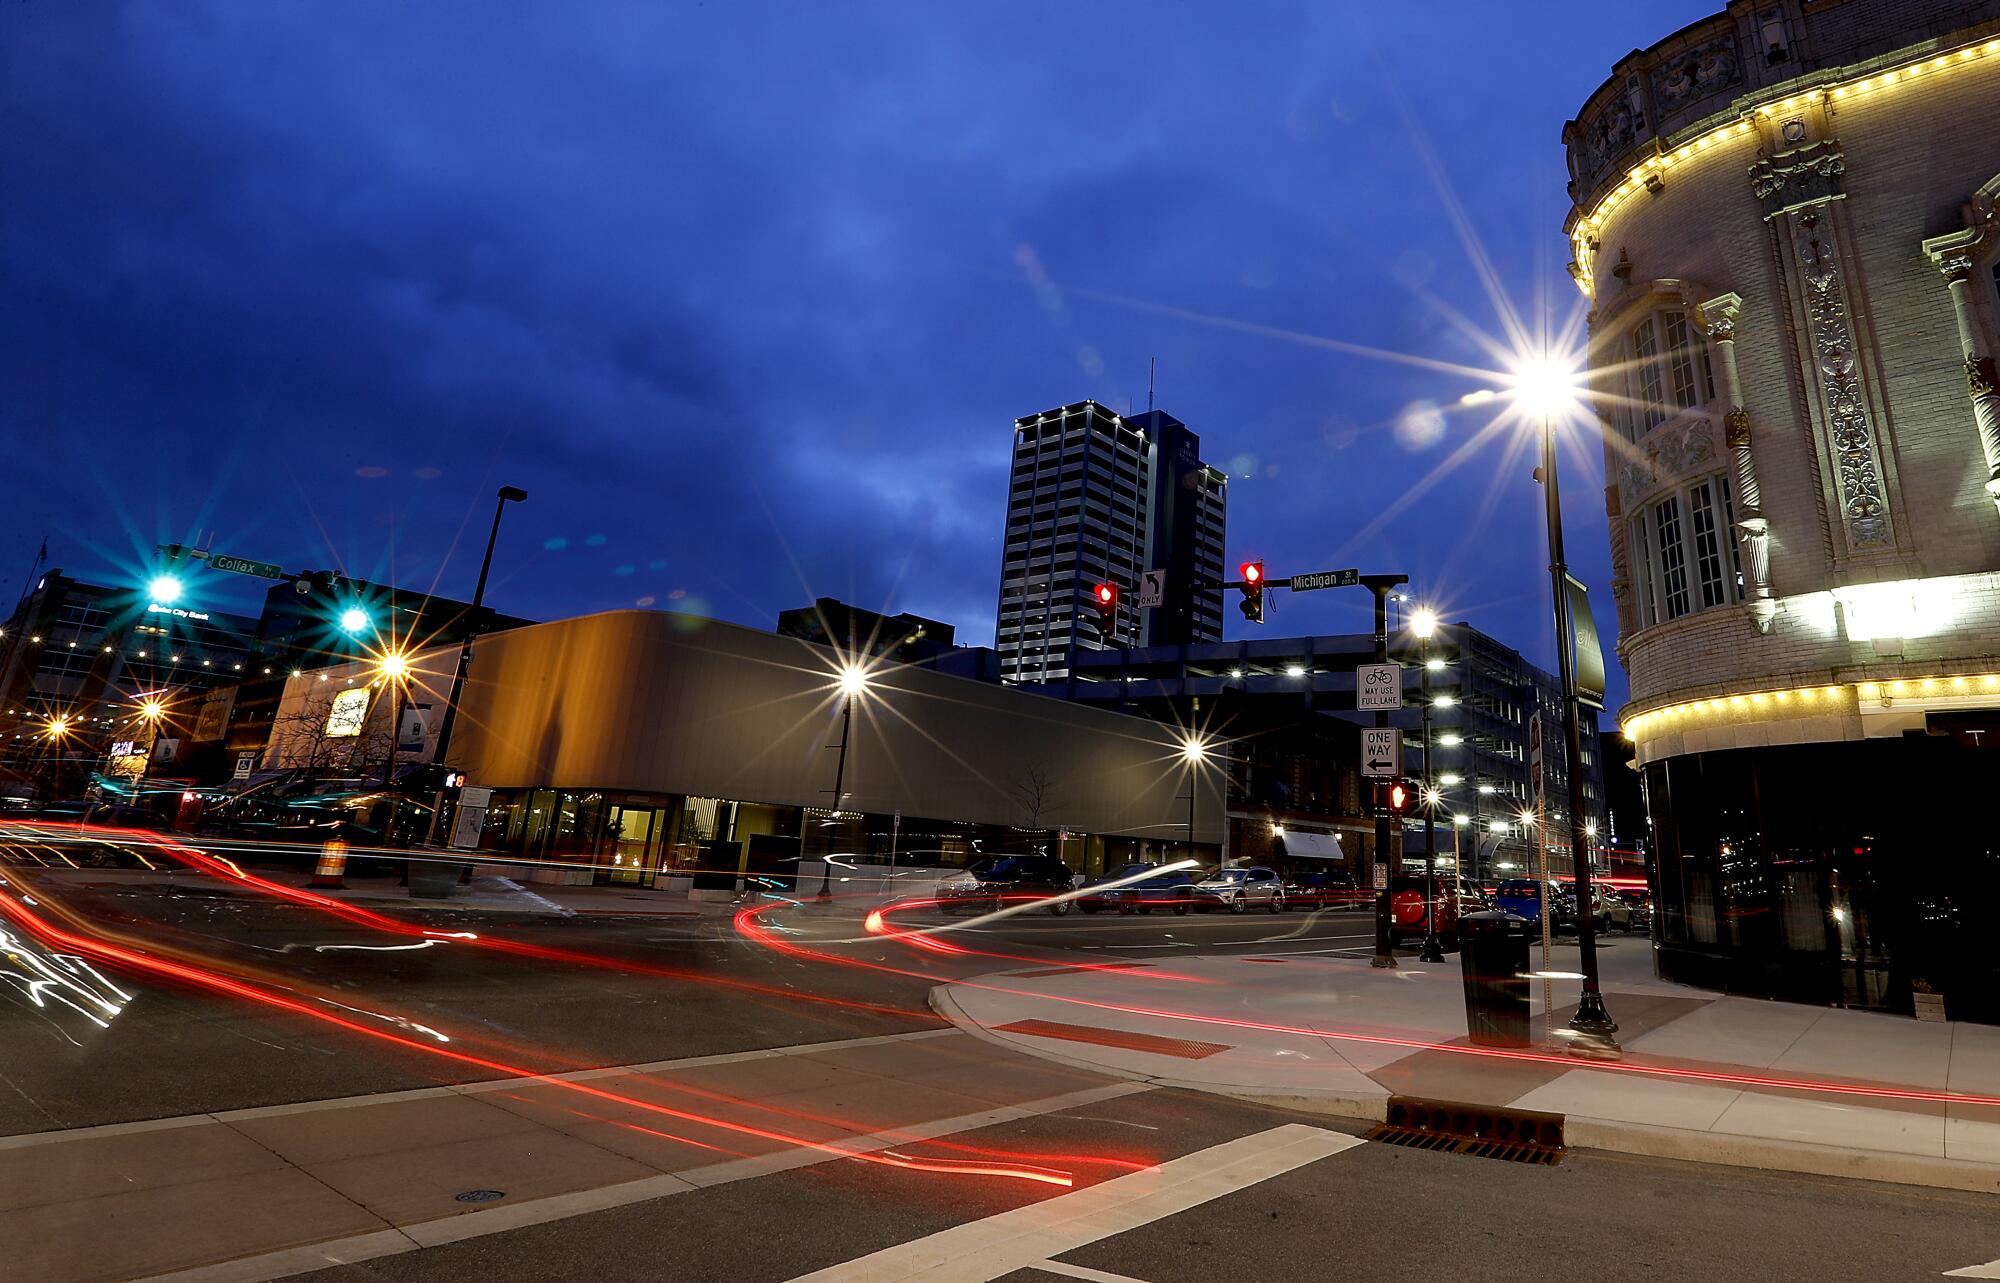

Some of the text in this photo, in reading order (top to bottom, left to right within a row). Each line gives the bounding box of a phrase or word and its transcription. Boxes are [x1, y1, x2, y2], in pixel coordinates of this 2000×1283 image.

[218, 557, 256, 574] Colfax
[1294, 574, 1337, 589] Michigan
[1141, 595, 1160, 605] ONLY
[172, 608, 188, 618] City
[189, 611, 209, 621] Bank
[1365, 686, 1394, 696] MAY USE
[1361, 696, 1397, 705] FULL LANE
[1368, 732, 1391, 744] ONE
[1367, 744, 1391, 756] WAY
